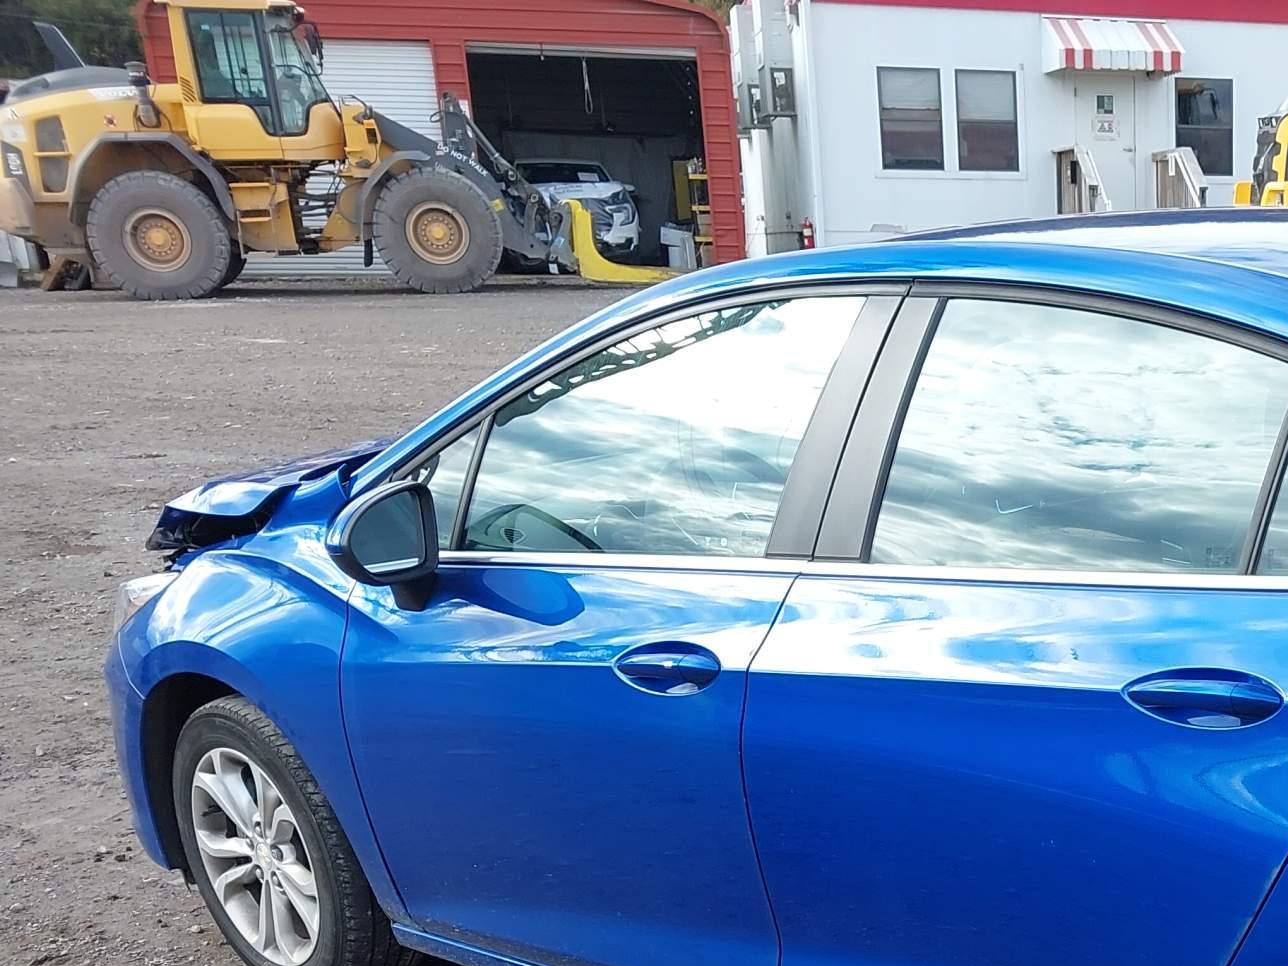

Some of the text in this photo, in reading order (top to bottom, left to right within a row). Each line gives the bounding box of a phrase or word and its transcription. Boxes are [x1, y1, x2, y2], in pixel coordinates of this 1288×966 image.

[437, 142, 449, 153] DO
[450, 150, 468, 162] NOT
[468, 159, 489, 177] WALK
